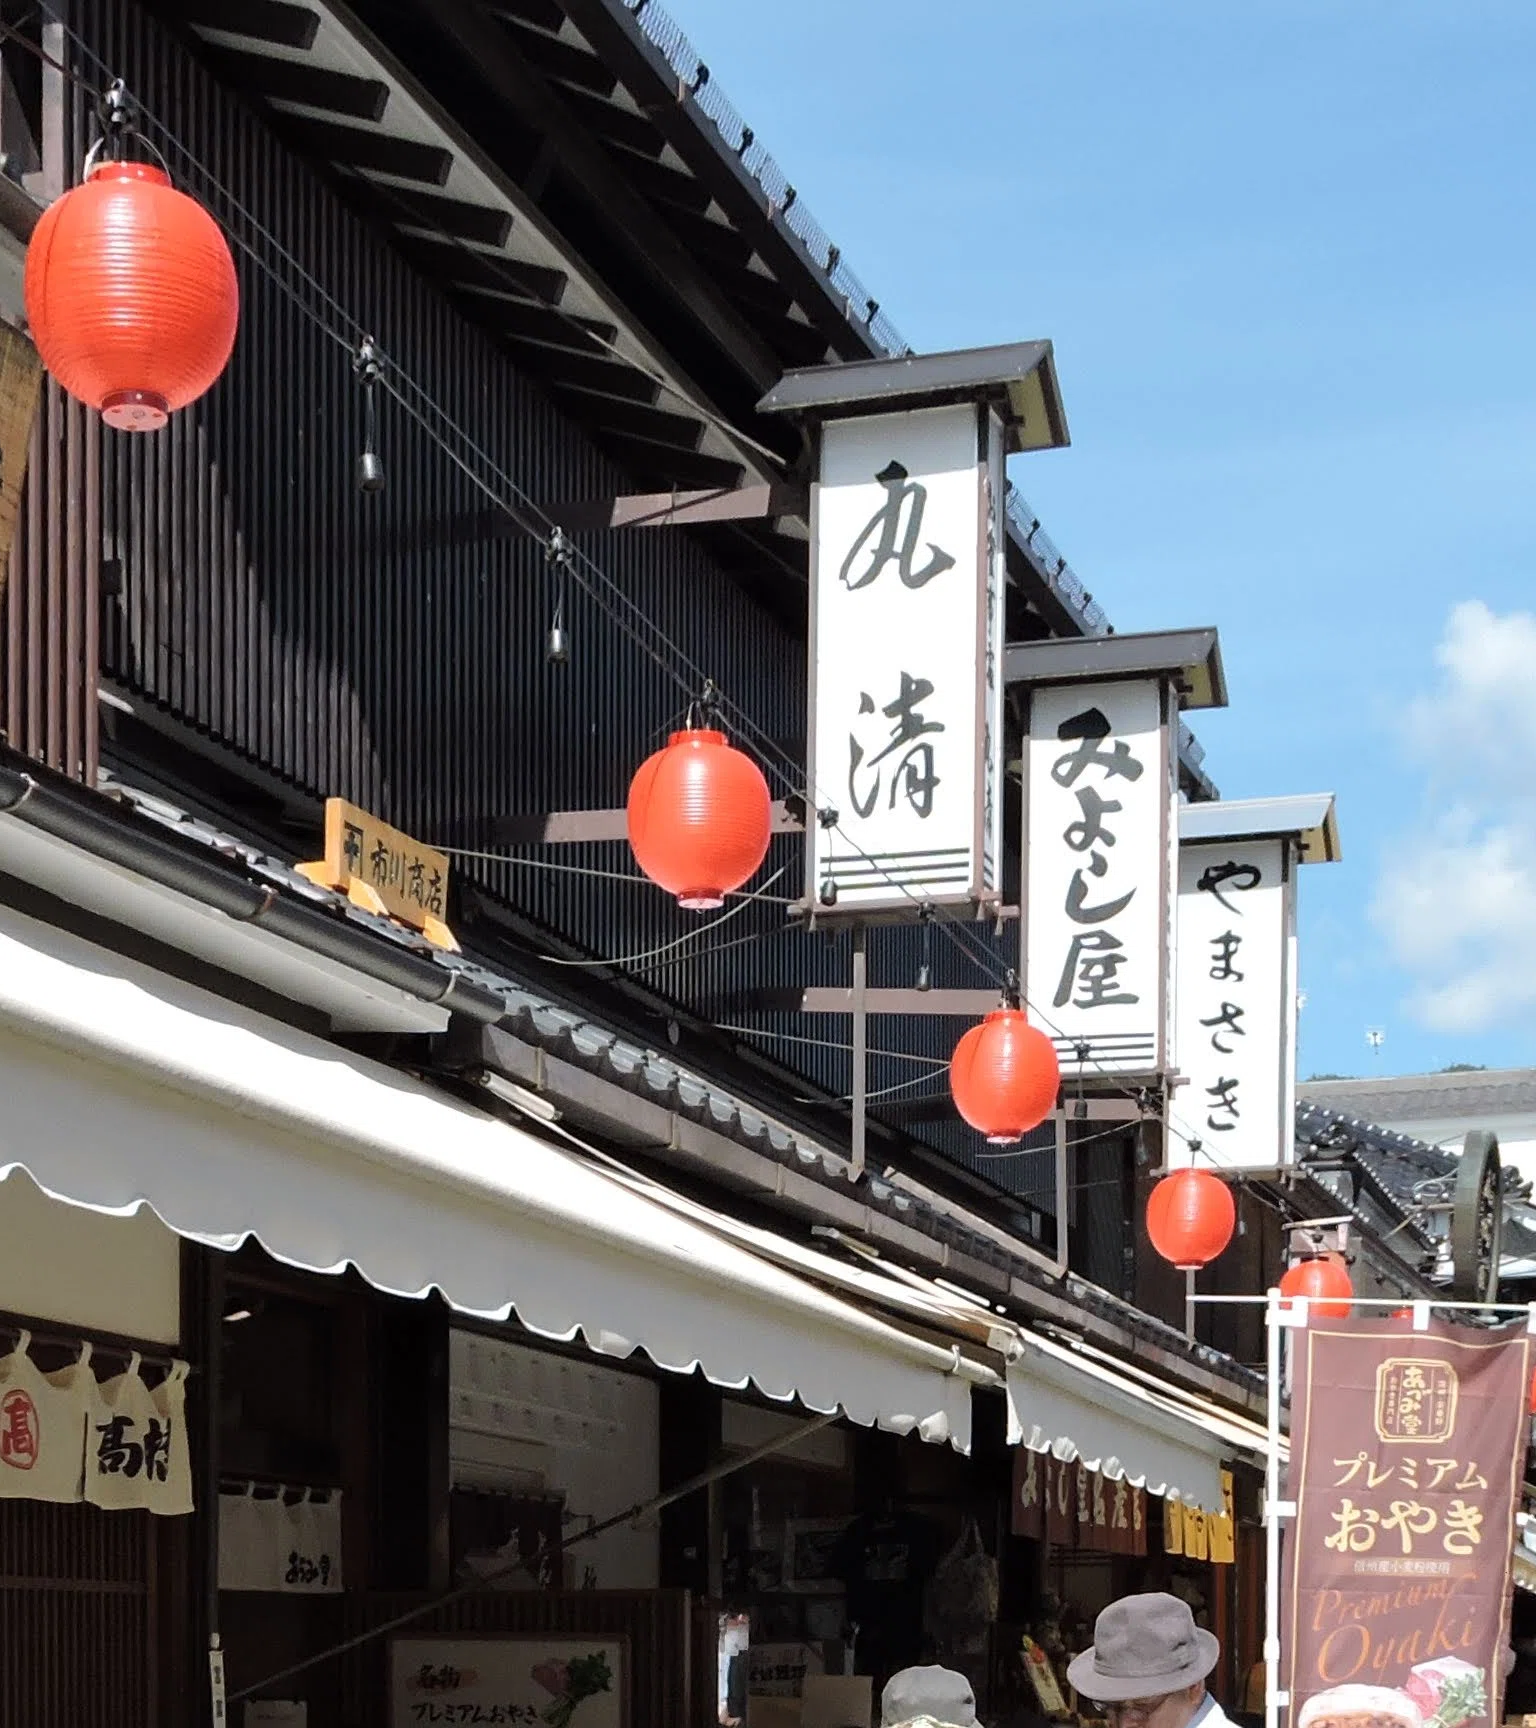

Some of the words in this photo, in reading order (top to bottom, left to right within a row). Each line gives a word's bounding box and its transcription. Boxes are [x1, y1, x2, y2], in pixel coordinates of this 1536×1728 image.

[837, 460, 957, 821] 丸清
[1049, 706, 1146, 1012] みよし屋
[1196, 860, 1262, 1132] やまさき
[1324, 1497, 1484, 1556] おやき
[1332, 1450, 1489, 1490] プレミアム
[1317, 1575, 1476, 1685] Oyaki
